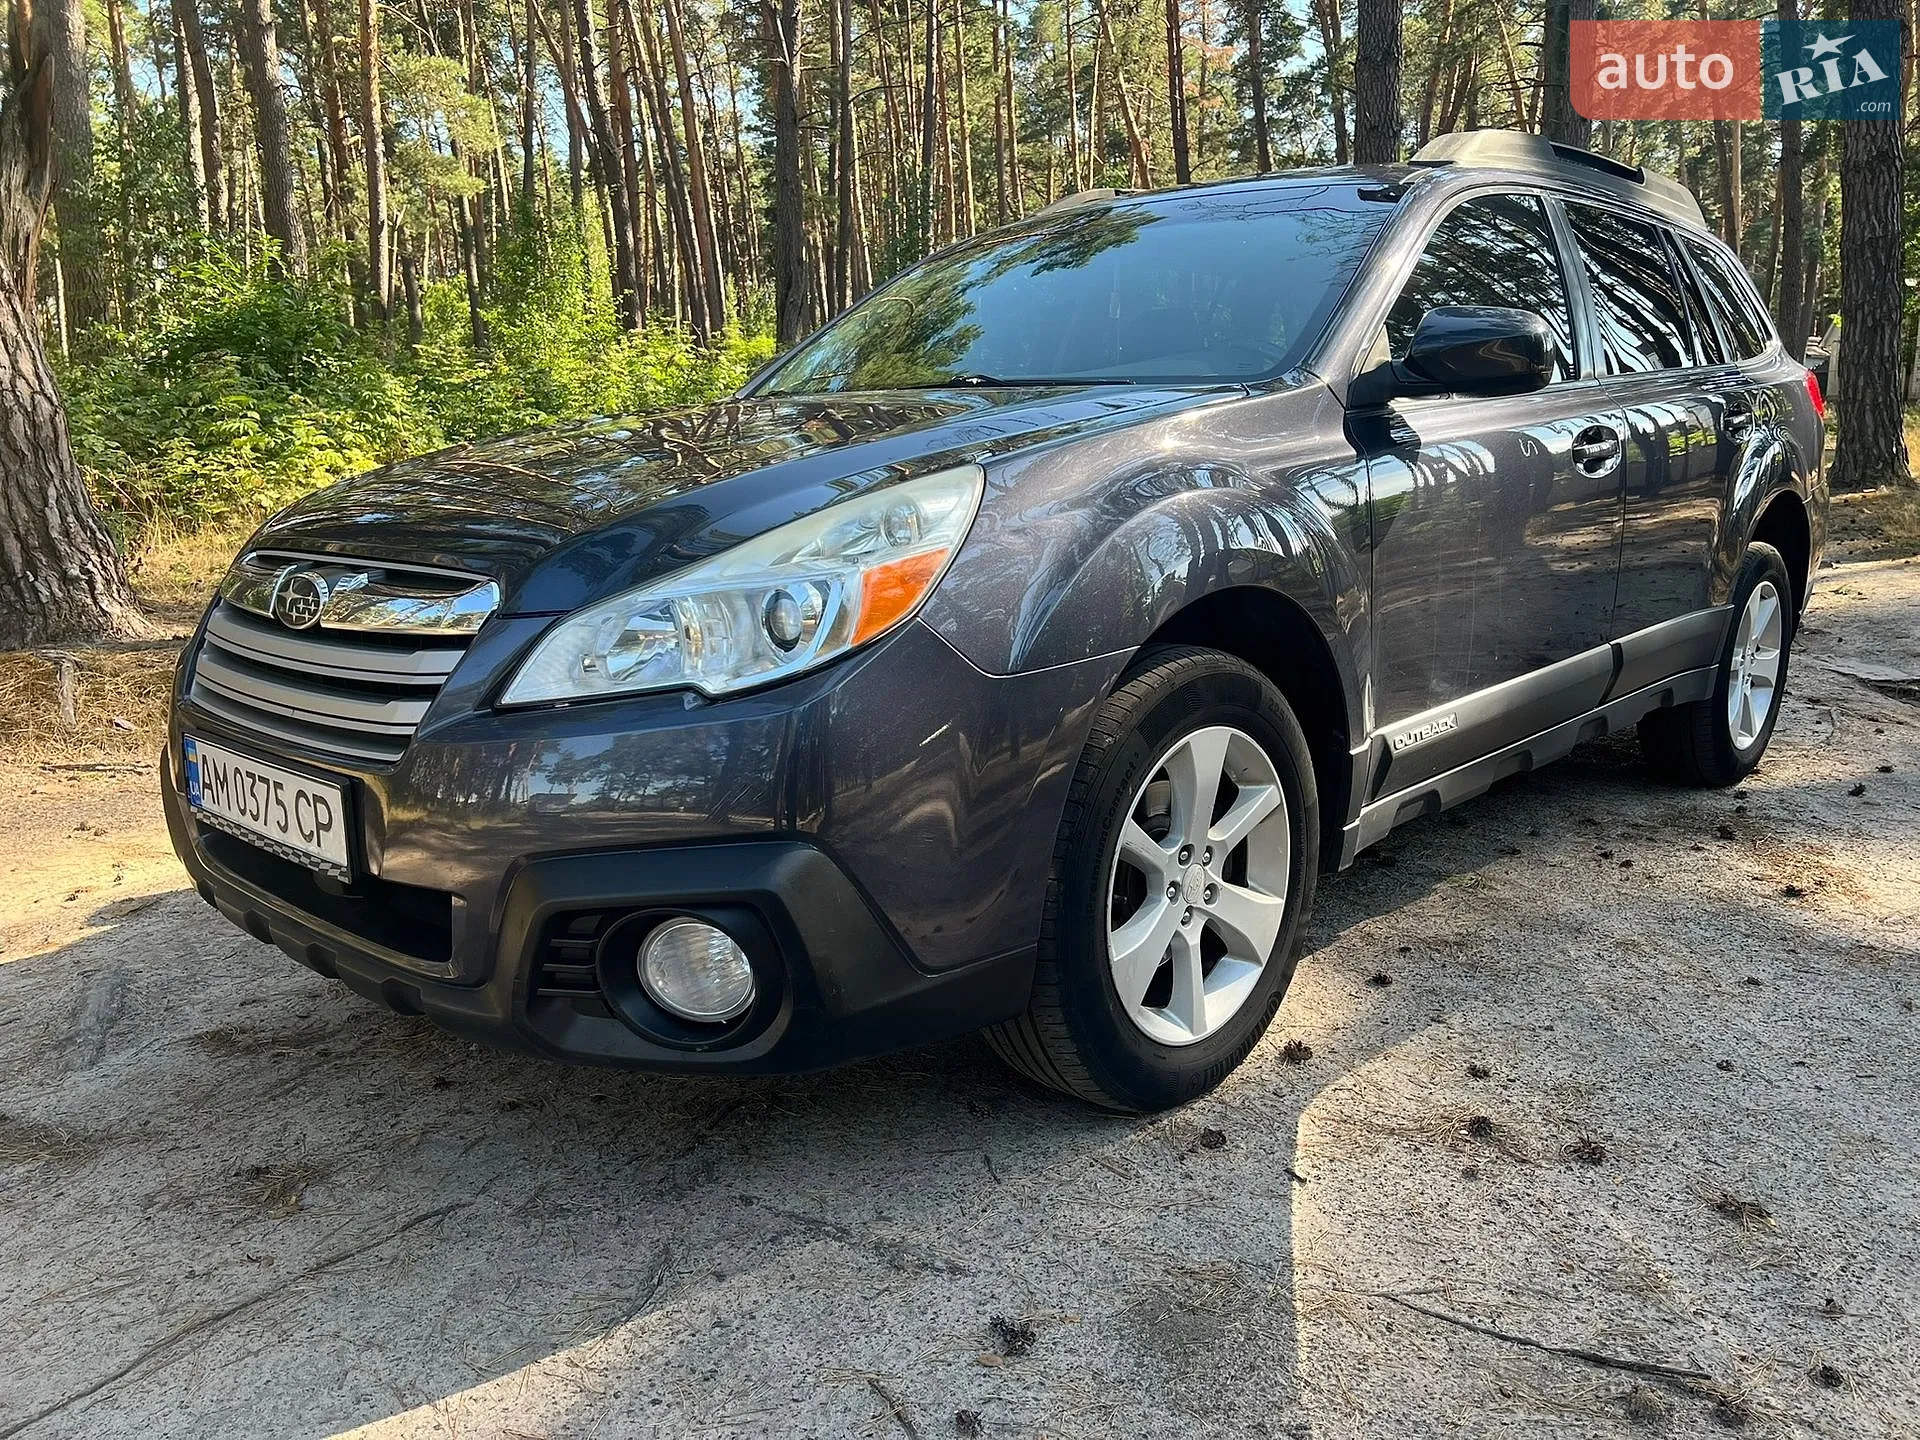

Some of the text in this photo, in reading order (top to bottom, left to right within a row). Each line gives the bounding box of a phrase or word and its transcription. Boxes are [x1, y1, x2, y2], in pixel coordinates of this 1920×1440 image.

[1393, 712, 1459, 750] OUTBACK
[201, 754, 333, 847] AM 0375 CP
